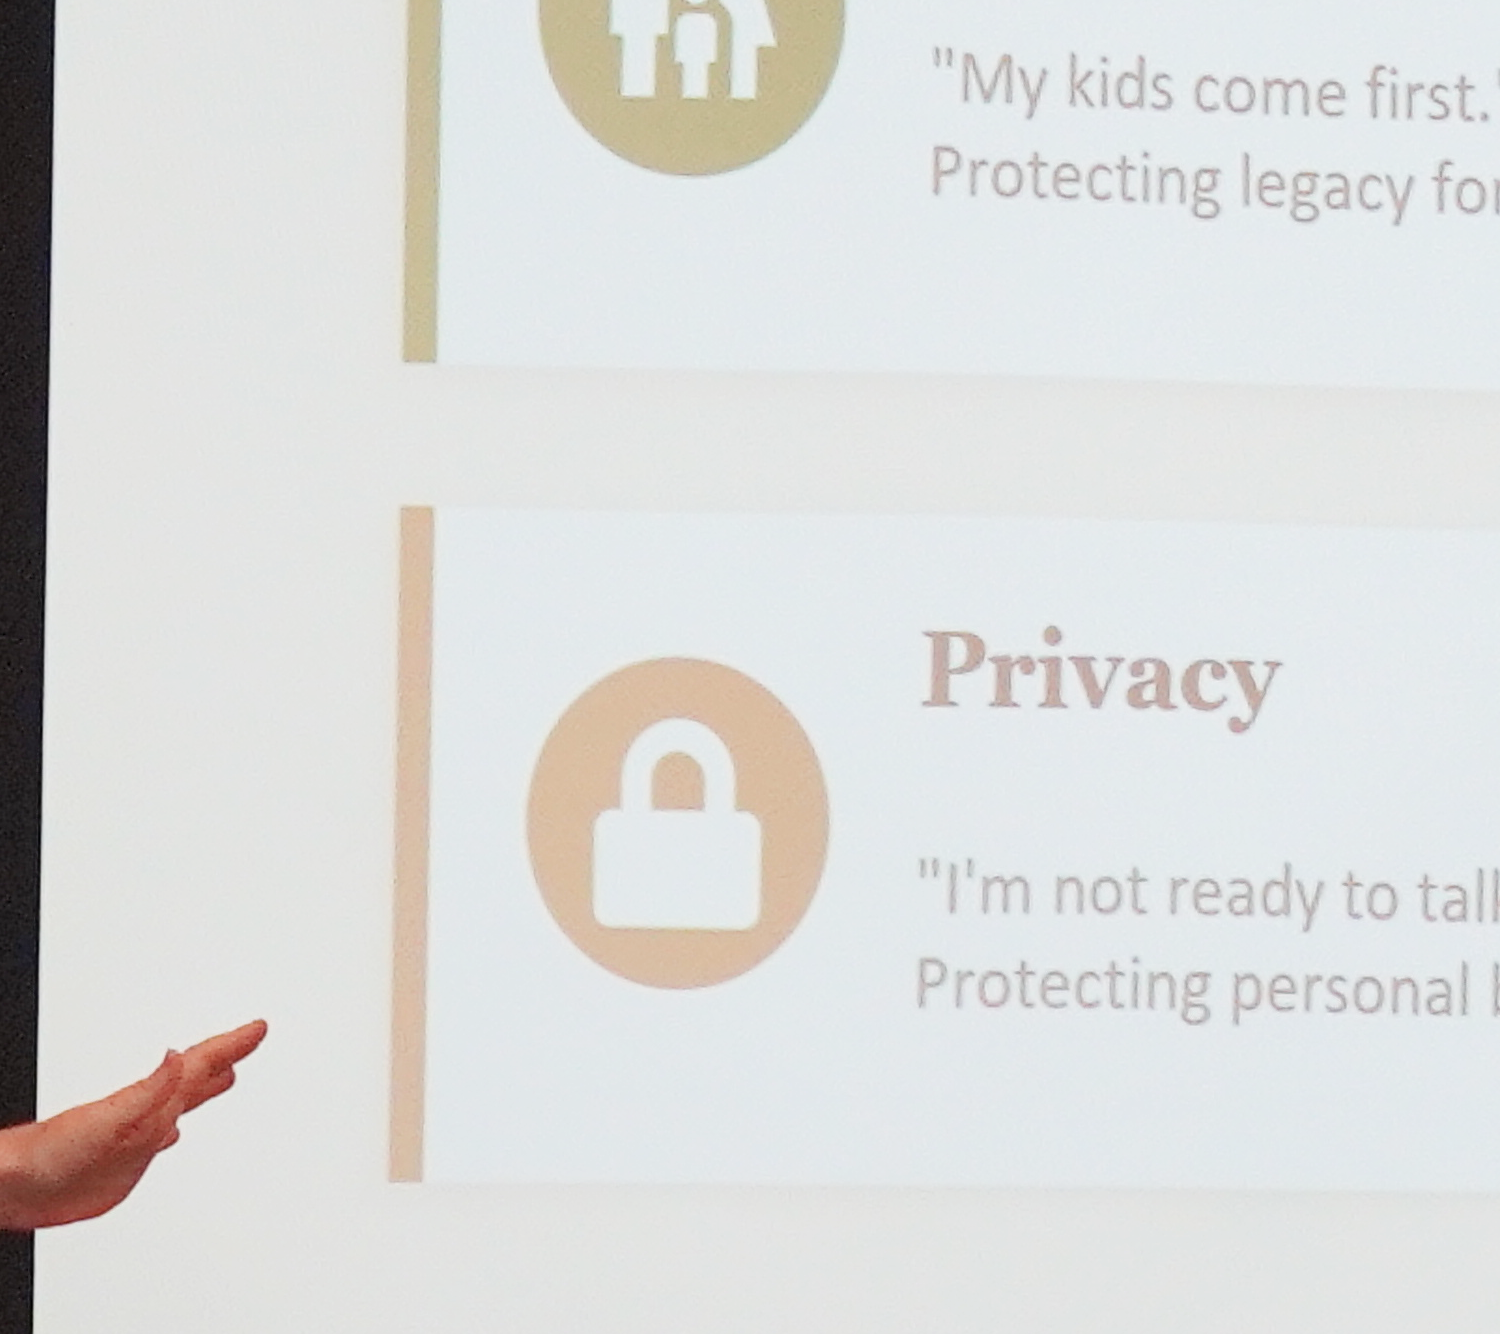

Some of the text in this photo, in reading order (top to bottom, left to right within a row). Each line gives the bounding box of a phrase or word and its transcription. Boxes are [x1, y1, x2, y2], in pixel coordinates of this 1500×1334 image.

[932, 45, 1049, 121] "My
[1068, 51, 1175, 113] kids
[1193, 73, 1347, 119] come
[931, 144, 1222, 221] Protecting
[1242, 151, 1416, 227] legacy
[920, 624, 1284, 735] Privacy
[918, 857, 1032, 916] "I'm
[1054, 866, 1149, 916] not
[1169, 861, 1326, 934] ready
[1340, 870, 1400, 922] to
[916, 955, 1213, 1027] Protecting
[1232, 960, 1470, 1028] personal
